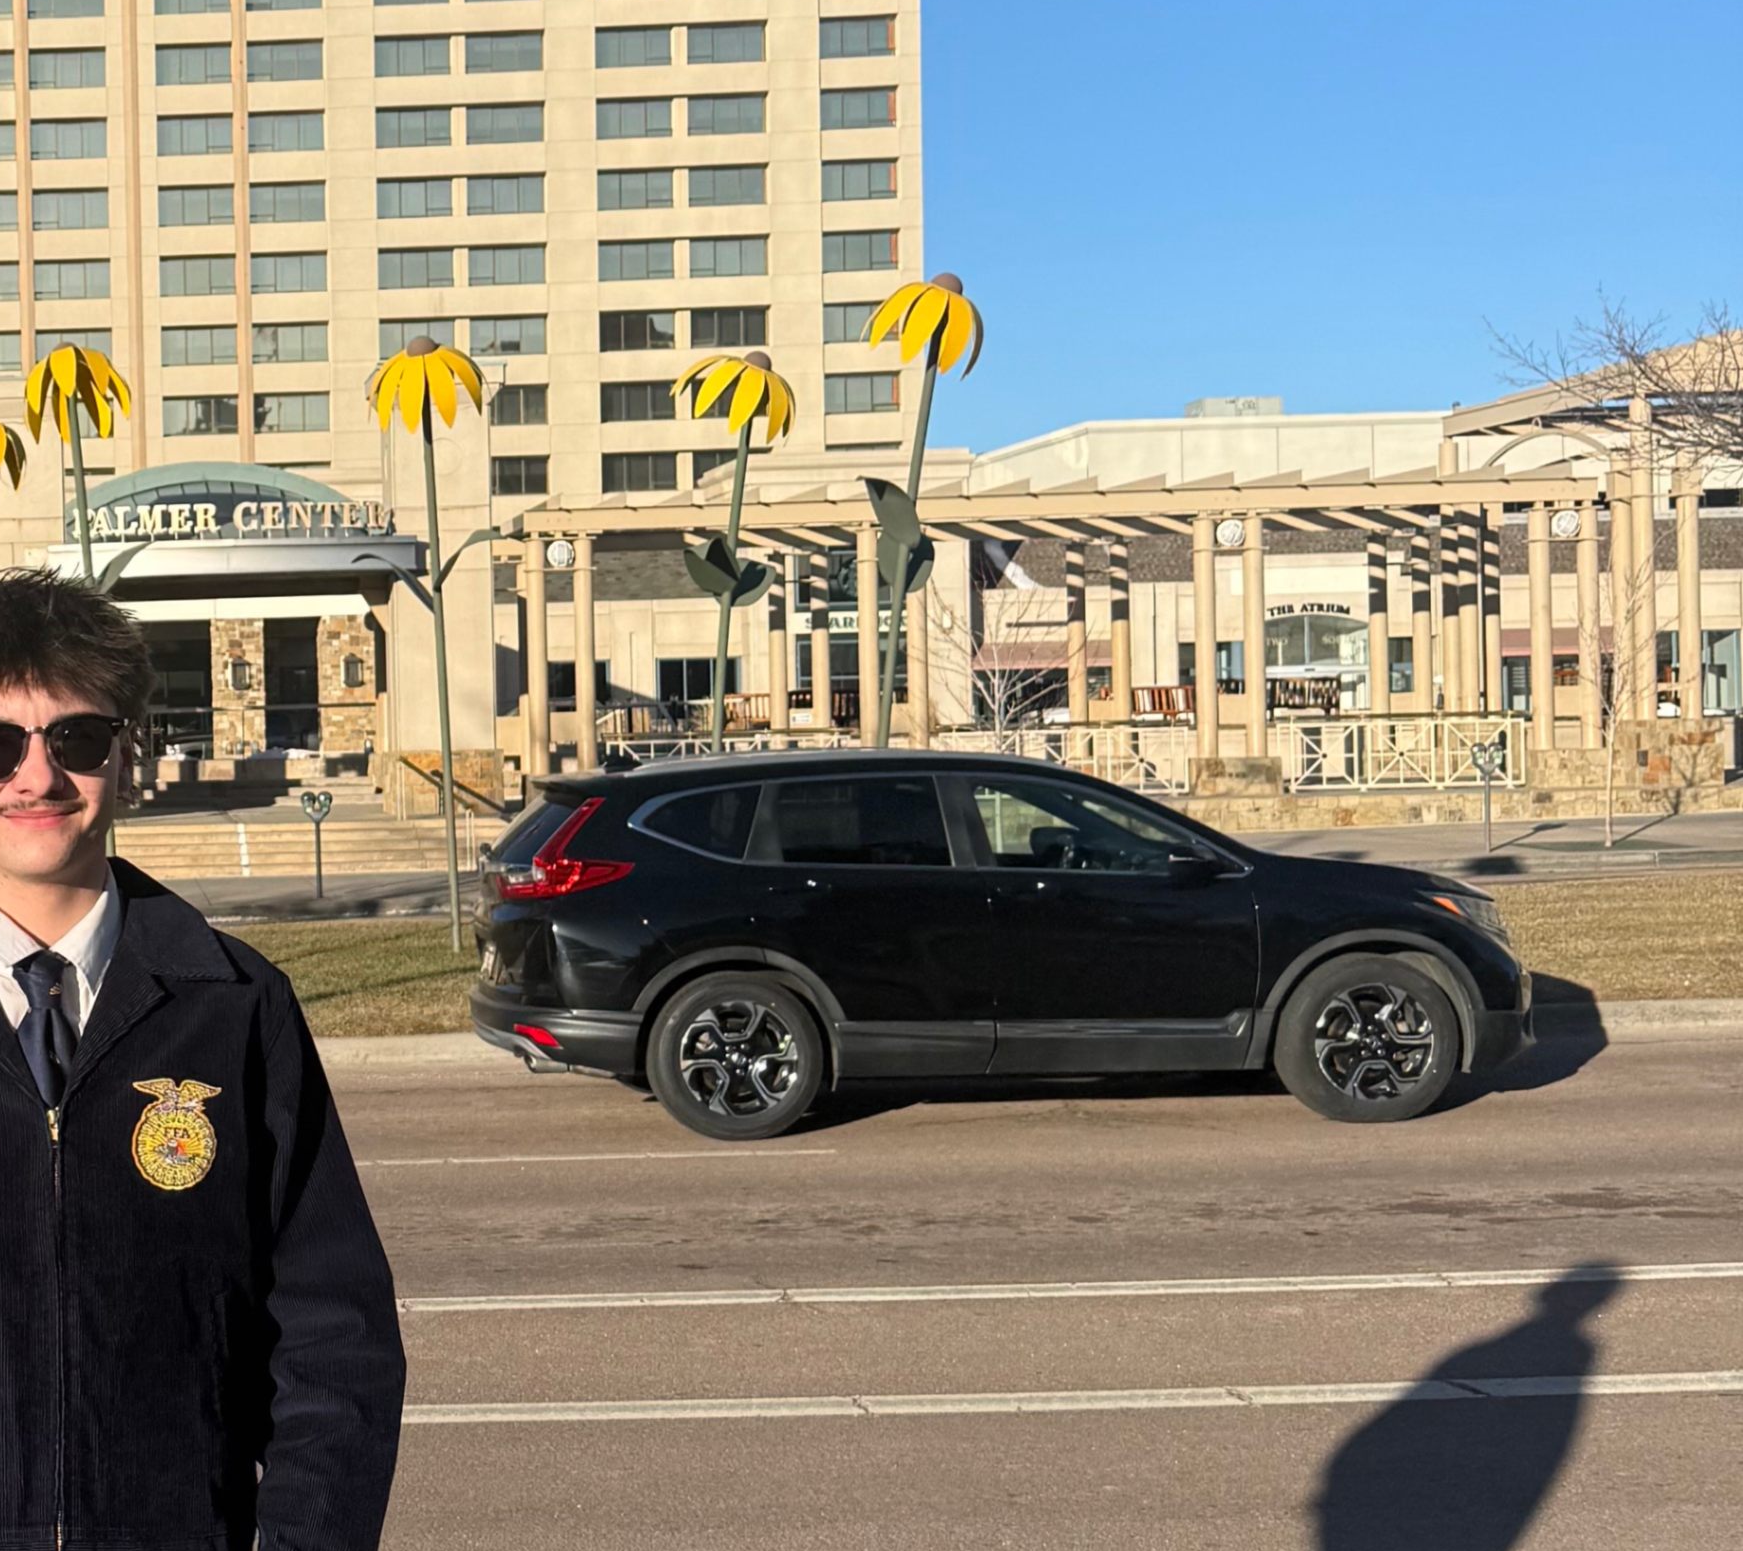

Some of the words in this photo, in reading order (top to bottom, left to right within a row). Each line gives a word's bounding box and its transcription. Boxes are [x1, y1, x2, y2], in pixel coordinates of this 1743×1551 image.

[233, 500, 390, 533] CENTER
[1266, 603, 1295, 617] THE
[1300, 602, 1351, 615] ATRIUM
[164, 1127, 191, 1139] FFA
